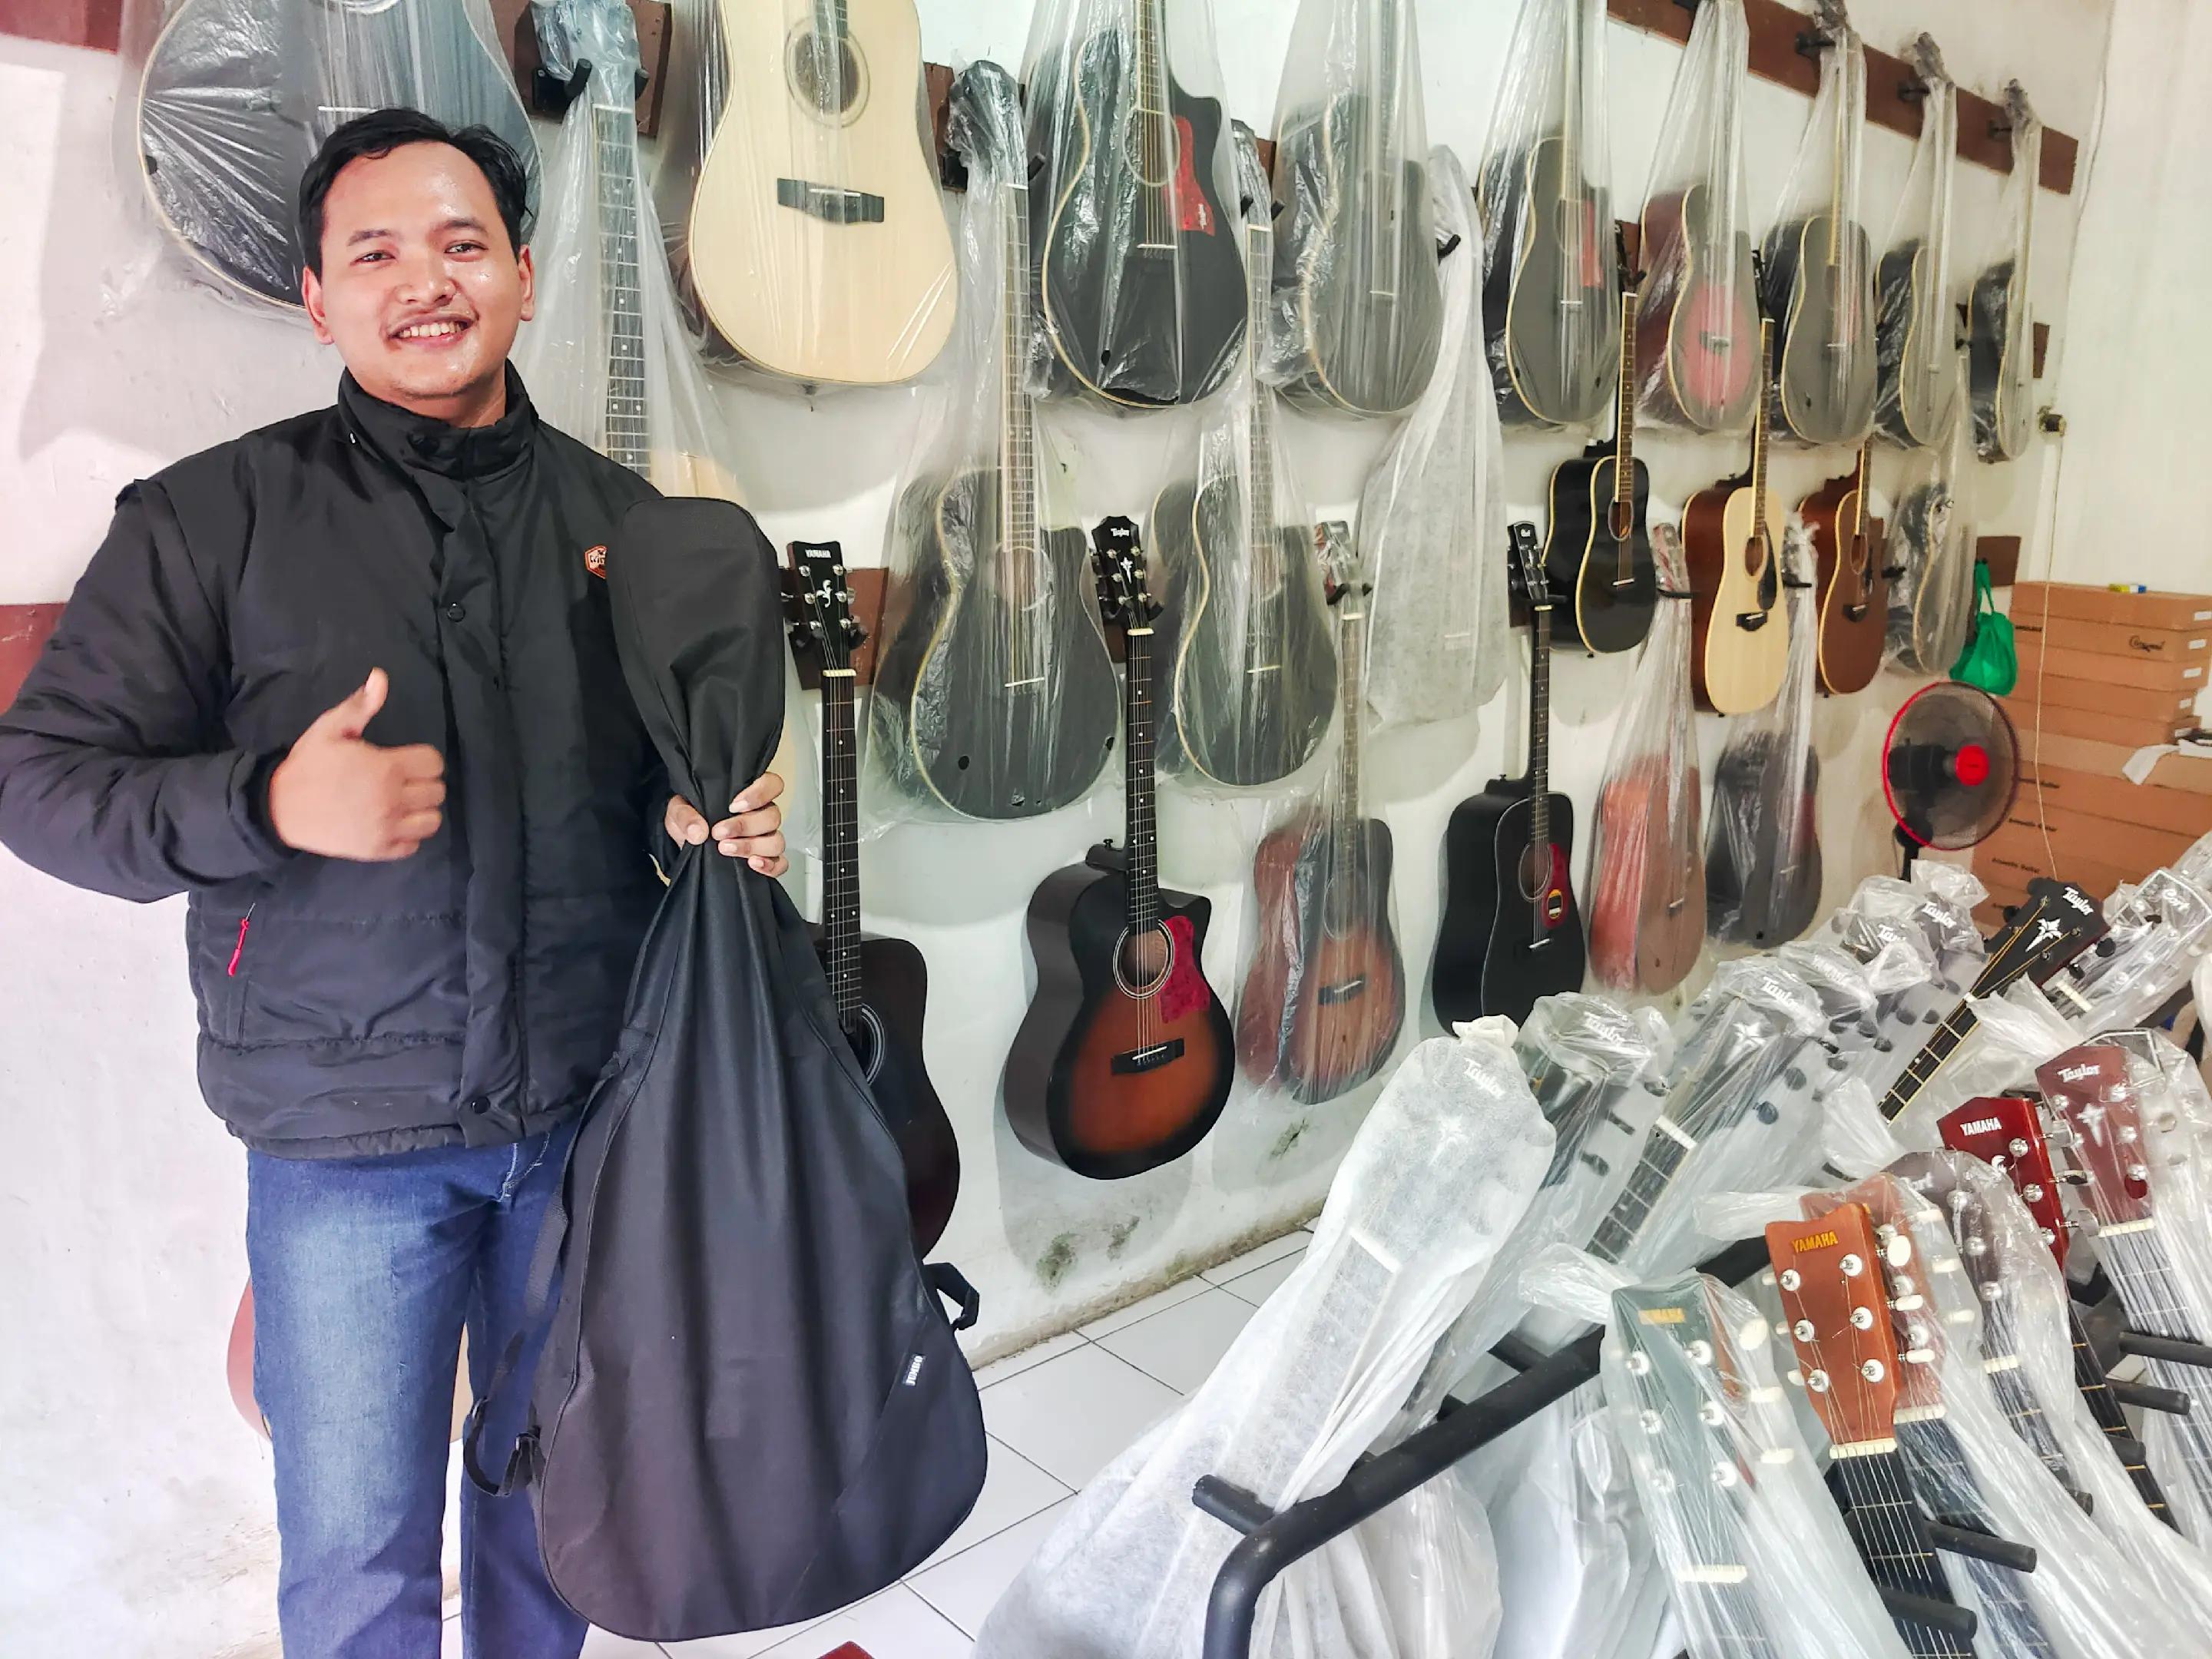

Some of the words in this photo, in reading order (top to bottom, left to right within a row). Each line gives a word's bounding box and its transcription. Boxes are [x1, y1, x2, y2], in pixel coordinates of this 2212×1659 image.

[806, 548, 831, 558] YAMAHA
[2062, 886, 2094, 916] Taylor
[1922, 901, 1957, 929] Taylor
[2058, 1063, 2101, 1082] Taylor
[1960, 1116, 2002, 1135] YAMAHA
[1791, 1230, 1838, 1253] YAMAHA
